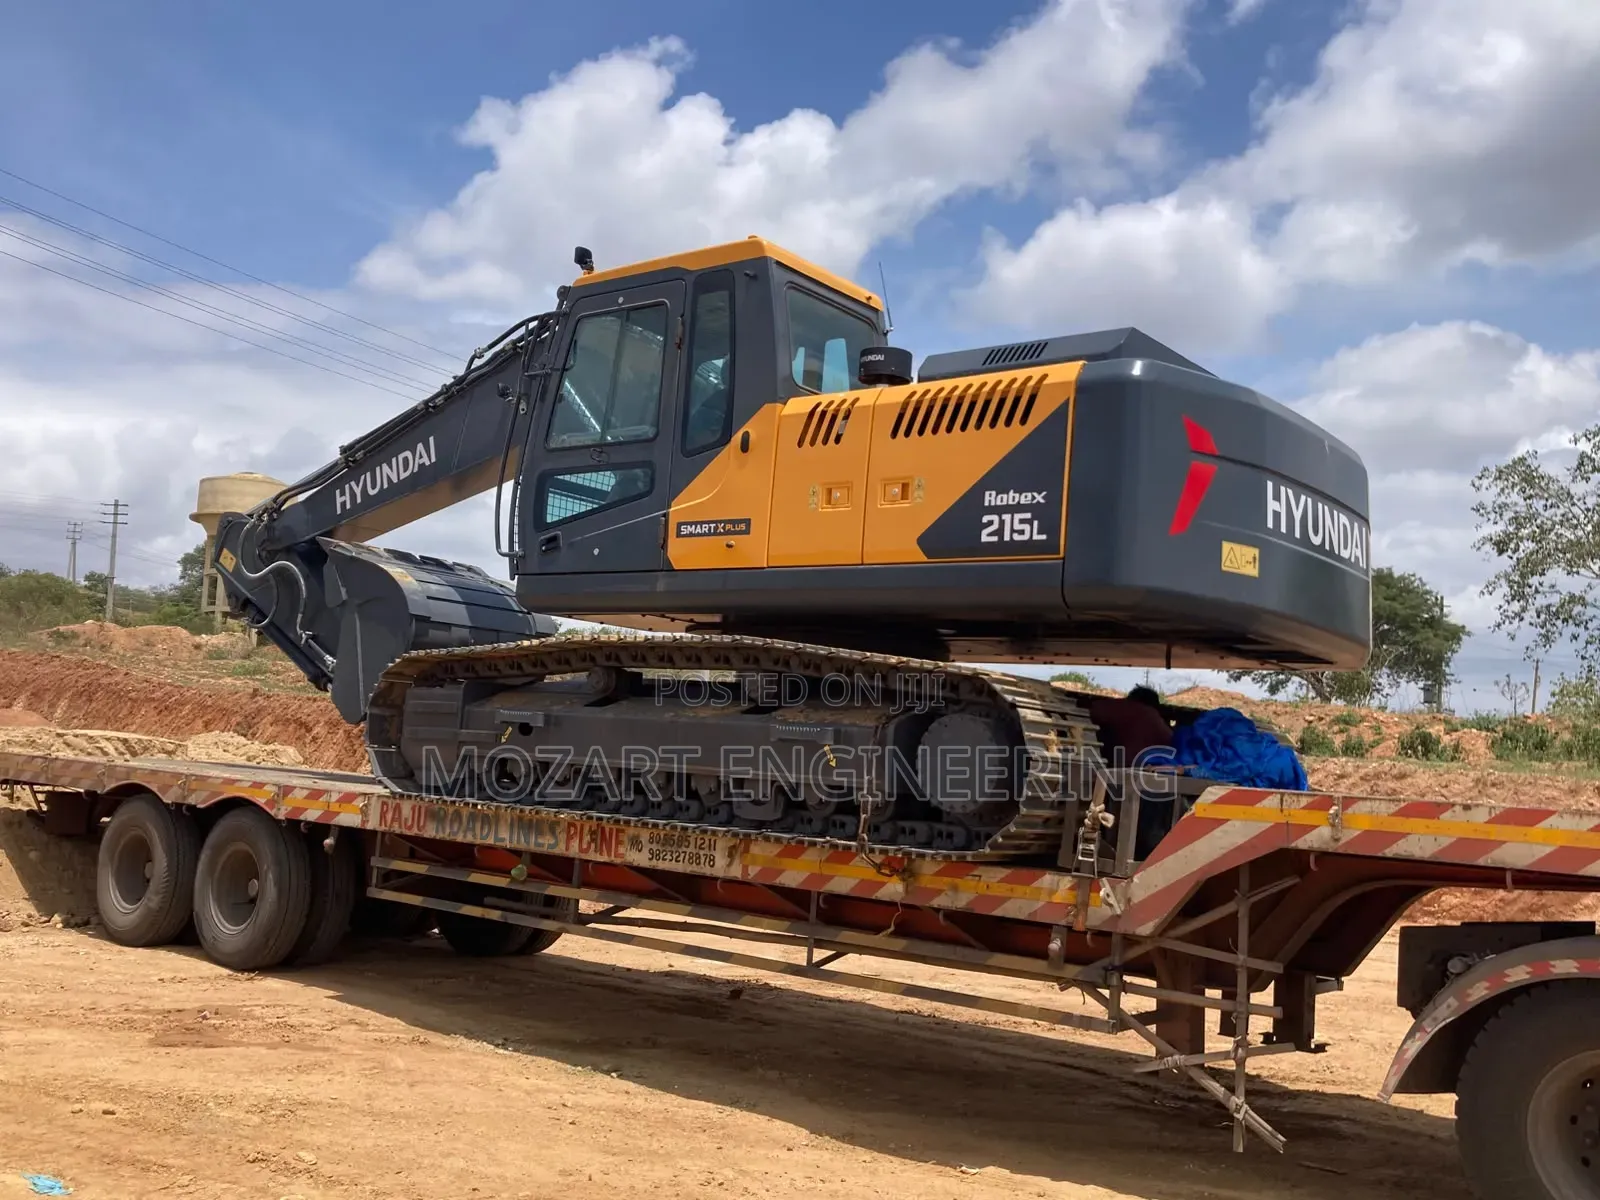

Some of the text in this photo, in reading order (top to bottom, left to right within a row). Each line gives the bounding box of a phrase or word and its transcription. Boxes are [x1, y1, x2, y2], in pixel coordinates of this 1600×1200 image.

[860, 354, 885, 363] UNDAI
[335, 435, 437, 515] HYUNDAI
[984, 489, 1047, 506] Robex
[725, 523, 746, 531] PLUS
[980, 512, 1047, 543] 215L
[1266, 480, 1367, 569] HYUNDAI
[379, 800, 626, 860] RAJU ROADLINES PUNE
[648, 847, 716, 868] 9823278878
